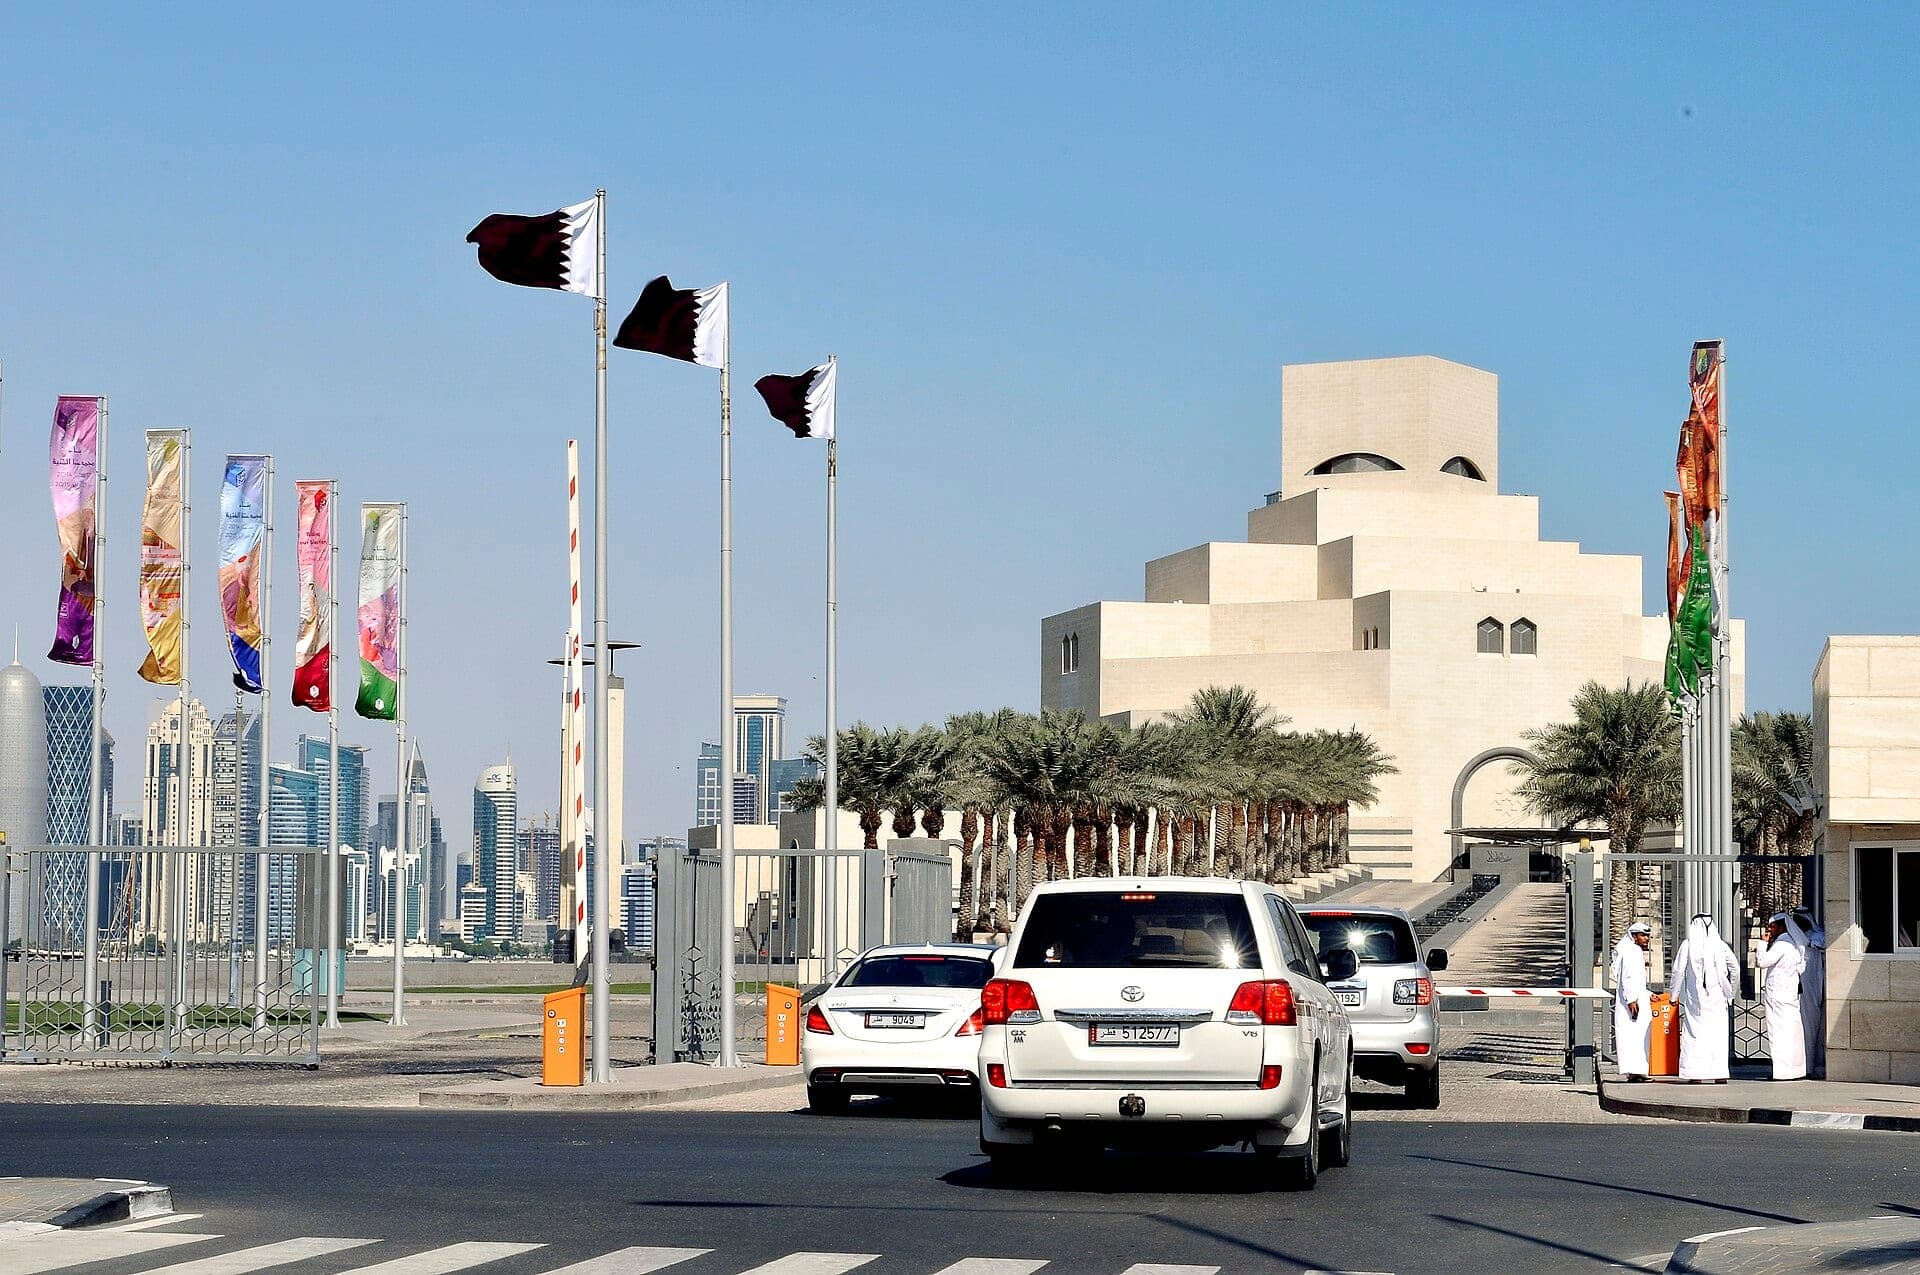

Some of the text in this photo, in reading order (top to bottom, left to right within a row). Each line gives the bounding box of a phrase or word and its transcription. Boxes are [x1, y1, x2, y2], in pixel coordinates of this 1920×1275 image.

[892, 1015, 915, 1025] 9049
[1100, 1025, 1171, 1039] قطر 512577
